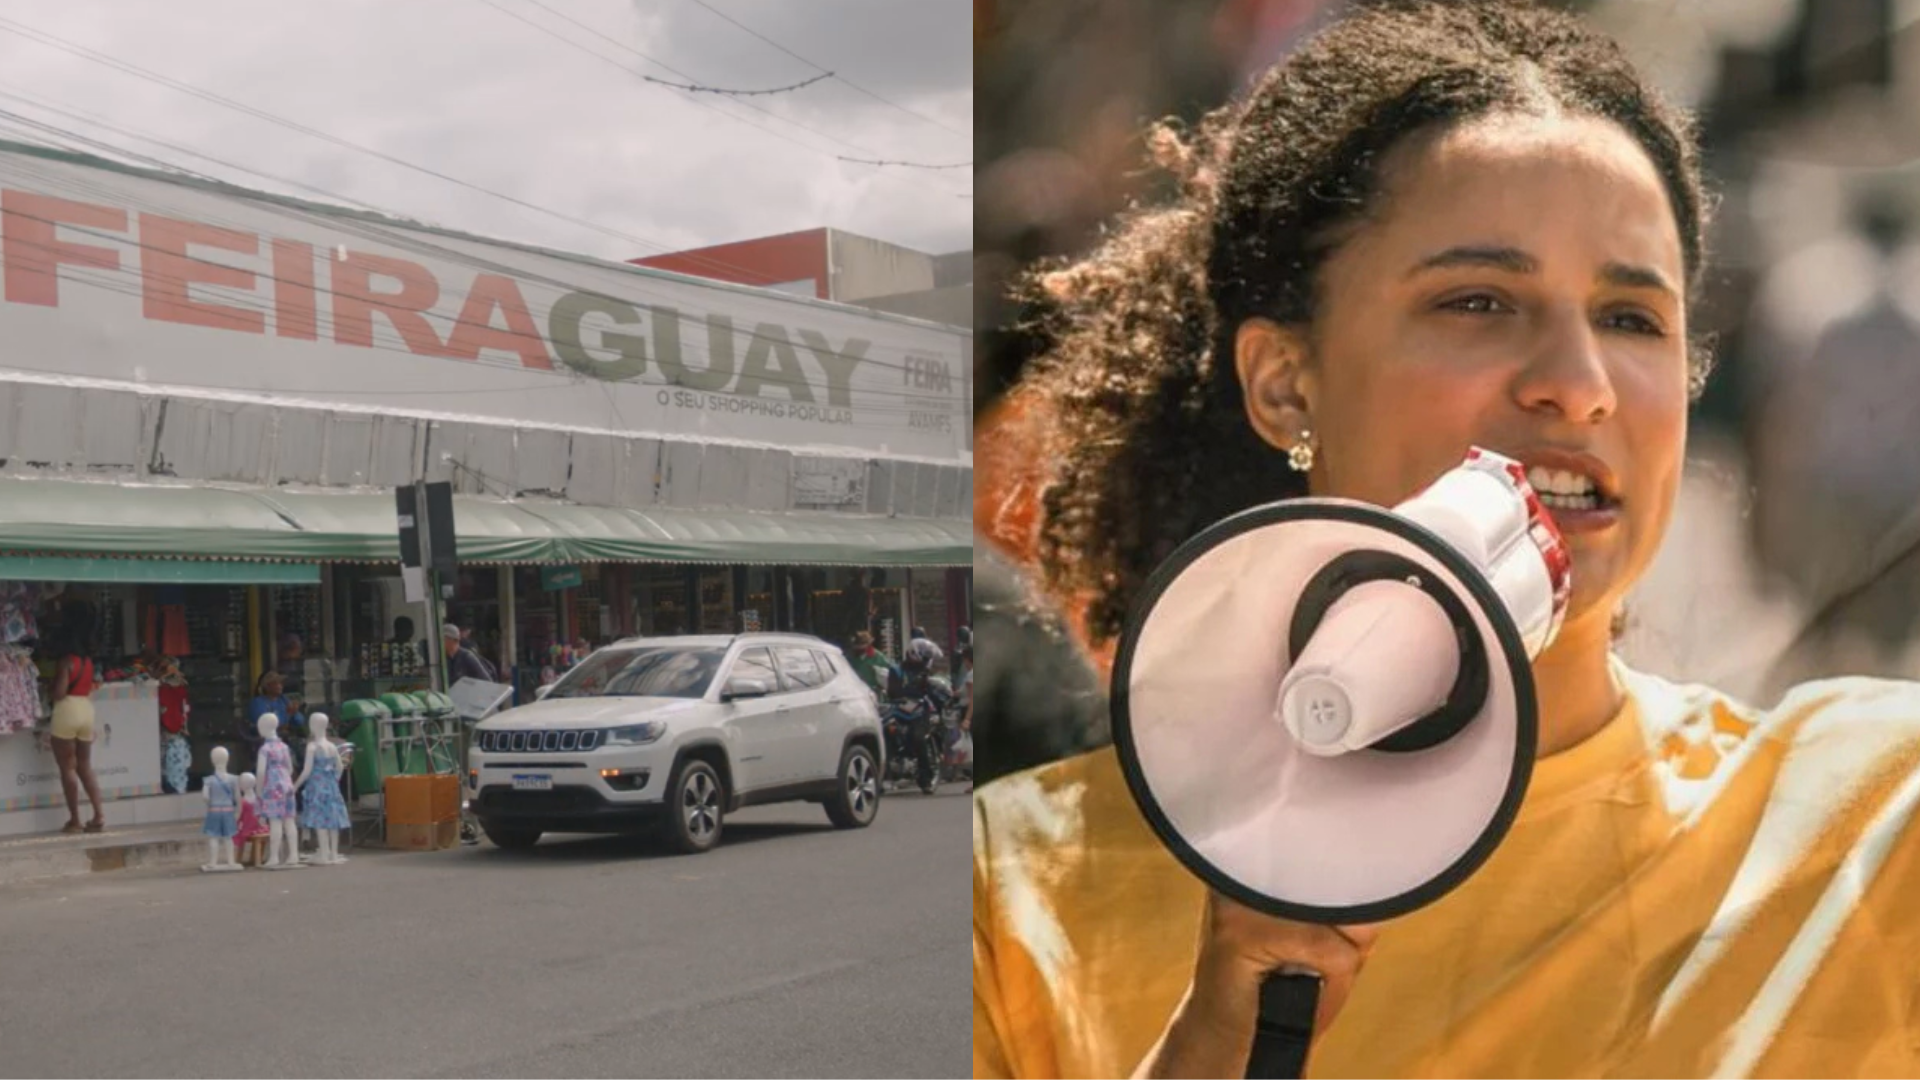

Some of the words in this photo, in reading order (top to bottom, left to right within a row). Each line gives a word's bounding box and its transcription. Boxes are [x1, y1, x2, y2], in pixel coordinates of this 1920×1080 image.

[2, 189, 872, 407] FEIRAGUAY
[903, 354, 953, 394] FEIRA
[656, 389, 670, 406] O
[674, 391, 705, 410] SEU
[709, 395, 785, 418] SHOPPING
[788, 405, 854, 425] POPULAR
